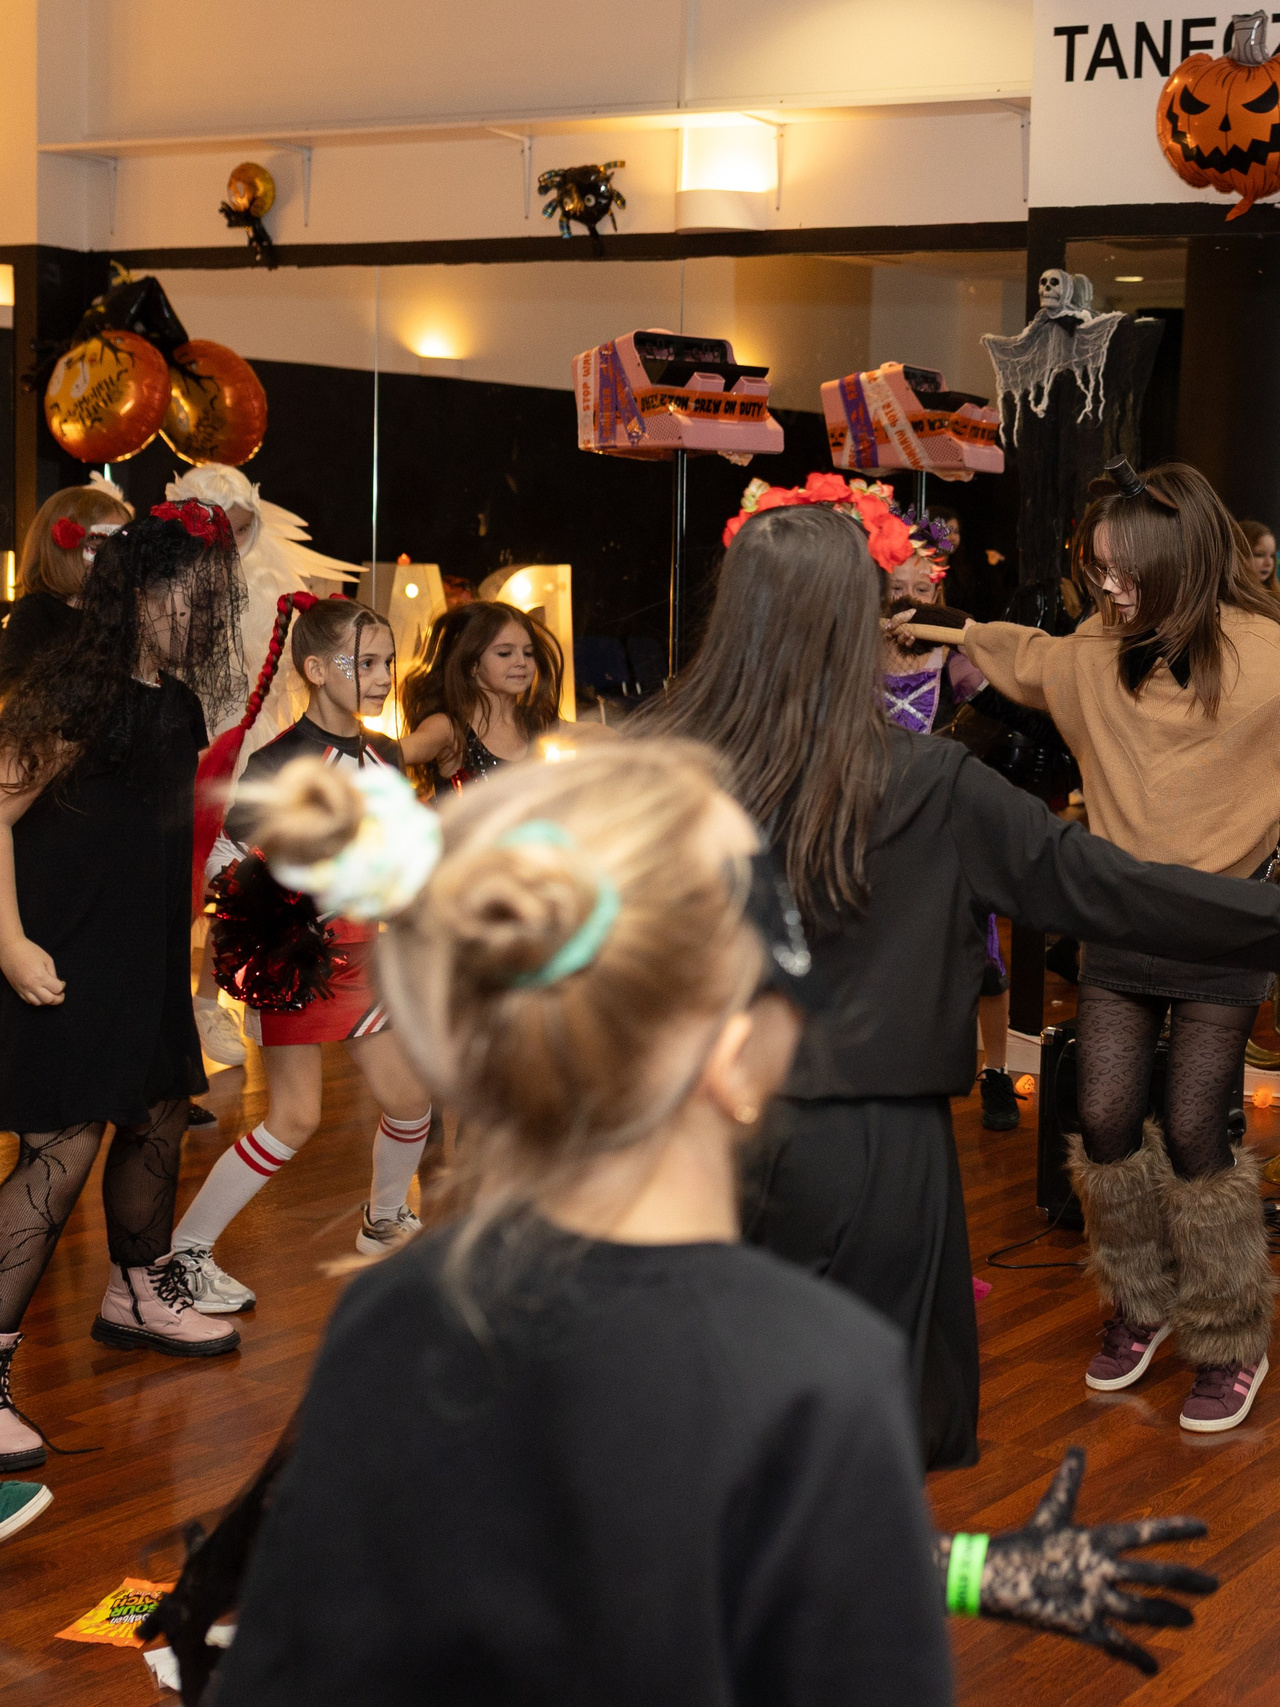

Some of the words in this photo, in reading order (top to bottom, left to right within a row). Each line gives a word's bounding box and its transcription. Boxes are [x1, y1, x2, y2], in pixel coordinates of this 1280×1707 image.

[582, 383, 591, 412] STOP
[693, 398, 722, 415] CREW
[724, 401, 737, 415] ON
[739, 402, 764, 417] DUTY
[110, 1603, 160, 1617] SOUR
